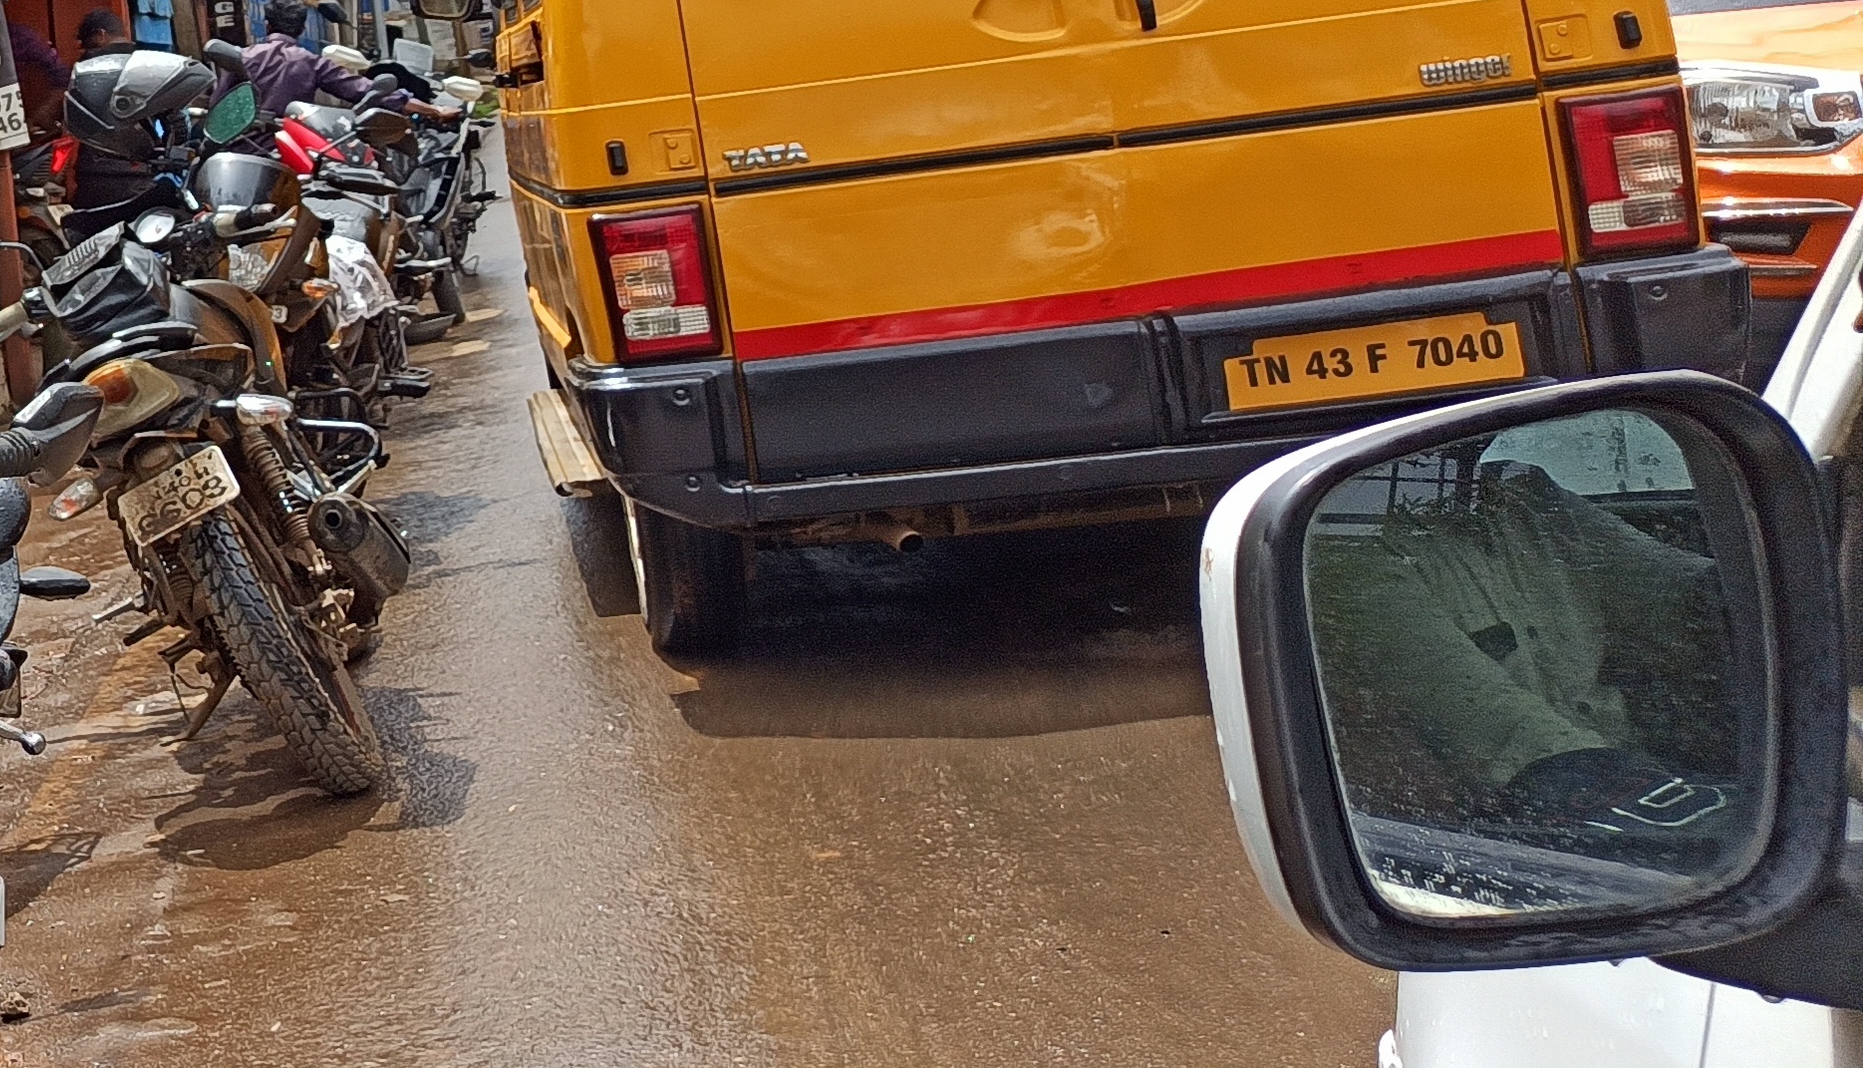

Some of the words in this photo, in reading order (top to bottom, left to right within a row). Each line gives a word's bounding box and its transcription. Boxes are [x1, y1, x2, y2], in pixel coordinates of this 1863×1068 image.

[722, 142, 810, 172] TATA
[1239, 354, 1291, 388] TN
[1305, 347, 1354, 380] 43
[1366, 342, 1388, 374] F
[1407, 328, 1505, 369] 7040
